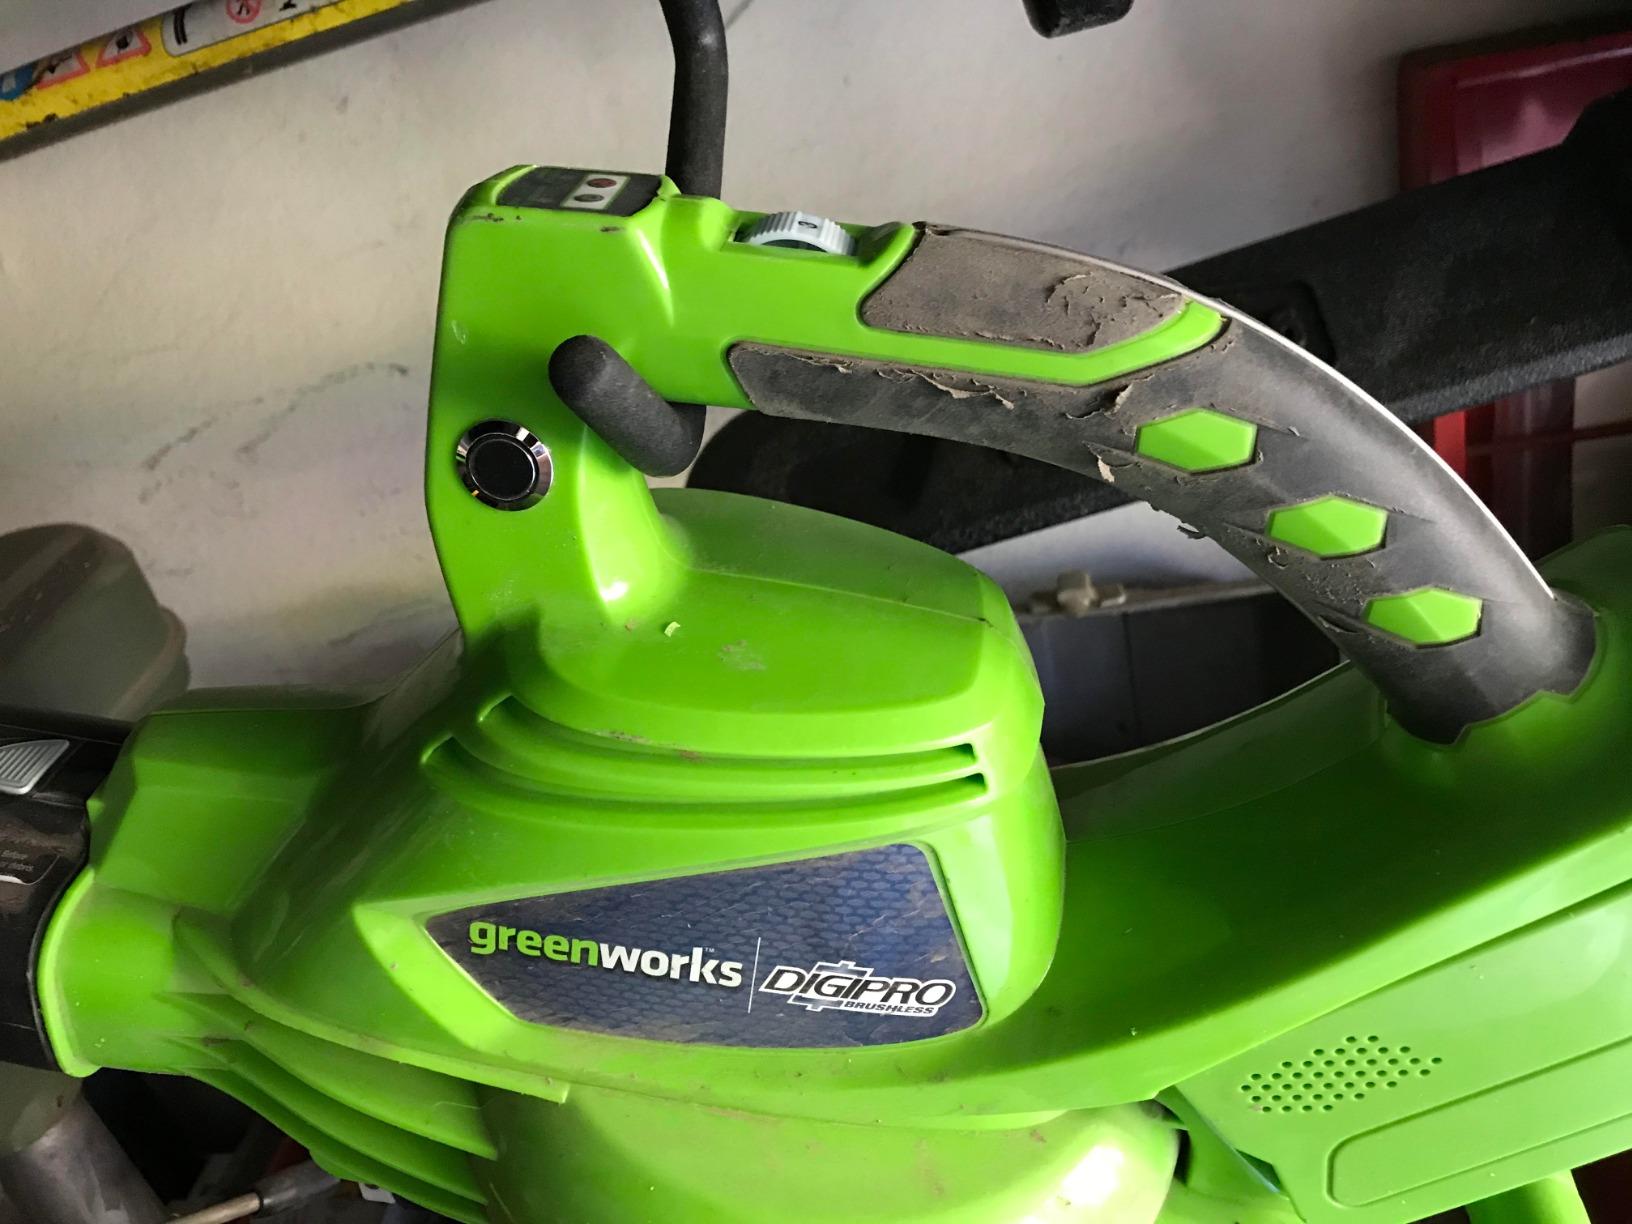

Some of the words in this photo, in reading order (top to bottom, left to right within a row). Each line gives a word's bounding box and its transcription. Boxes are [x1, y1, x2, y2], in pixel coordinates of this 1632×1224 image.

[468, 920, 744, 988] greenworks
[763, 967, 955, 1006] DIGIPRO
[843, 1000, 935, 1015] BRUSHLESS
